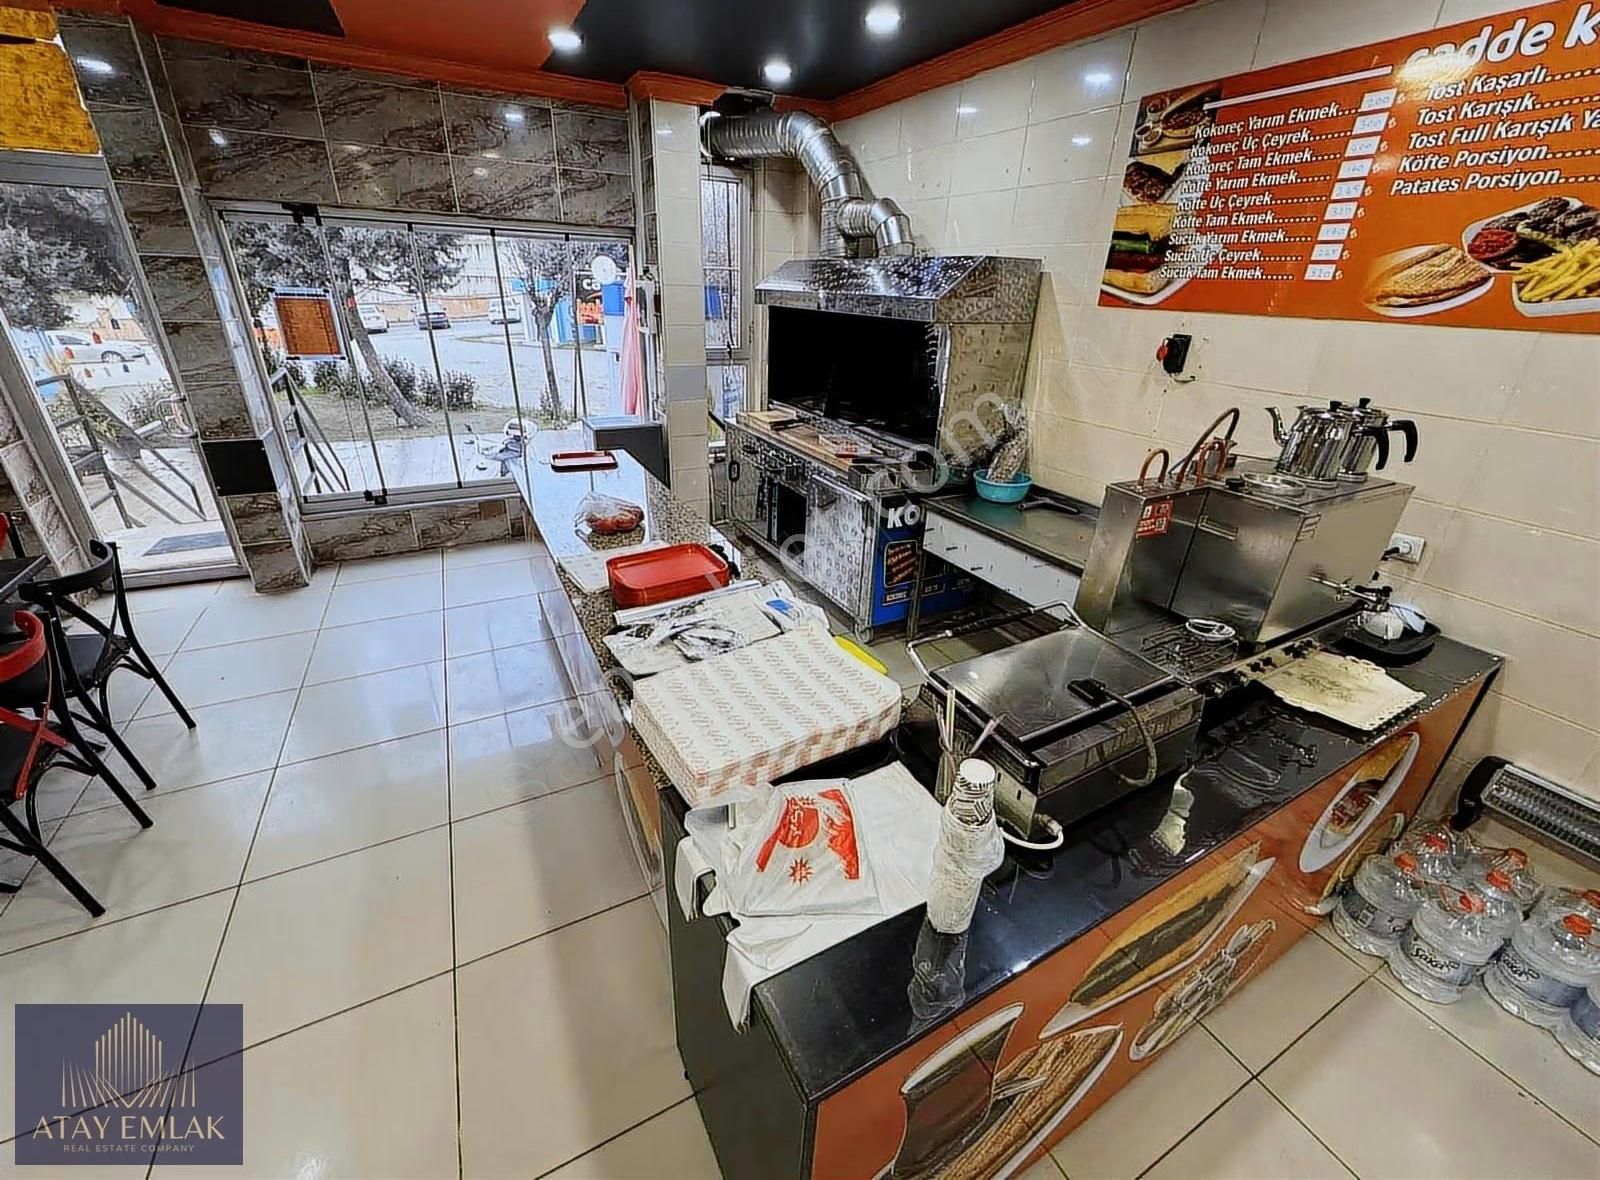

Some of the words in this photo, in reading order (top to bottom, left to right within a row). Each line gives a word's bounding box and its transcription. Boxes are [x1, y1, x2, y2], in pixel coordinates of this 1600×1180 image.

[1469, 65, 1547, 94] Kaşarlı
[1417, 107, 1457, 126] Tost
[1459, 93, 1537, 119] Karışık
[1195, 120, 1244, 139] Kokoreç
[1248, 114, 1284, 131] Yarım
[1408, 131, 1449, 150] Tost
[1449, 122, 1491, 145] Full
[1492, 113, 1576, 140] Karışık
[1191, 140, 1239, 158] Kokoreç
[1398, 154, 1449, 173] Köfte
[1453, 144, 1548, 169] Porsiyon
[1186, 156, 1234, 175] Kokoreç
[1237, 154, 1262, 171] Tam
[1215, 173, 1249, 190] Yarım
[1390, 177, 1461, 197] Patates
[1464, 168, 1561, 193] Porsiyon
[1205, 213, 1229, 227] Tam
[1169, 232, 1203, 246] Sucuk
[1165, 249, 1201, 263] Sucuk
[1160, 265, 1196, 280] Sucuk
